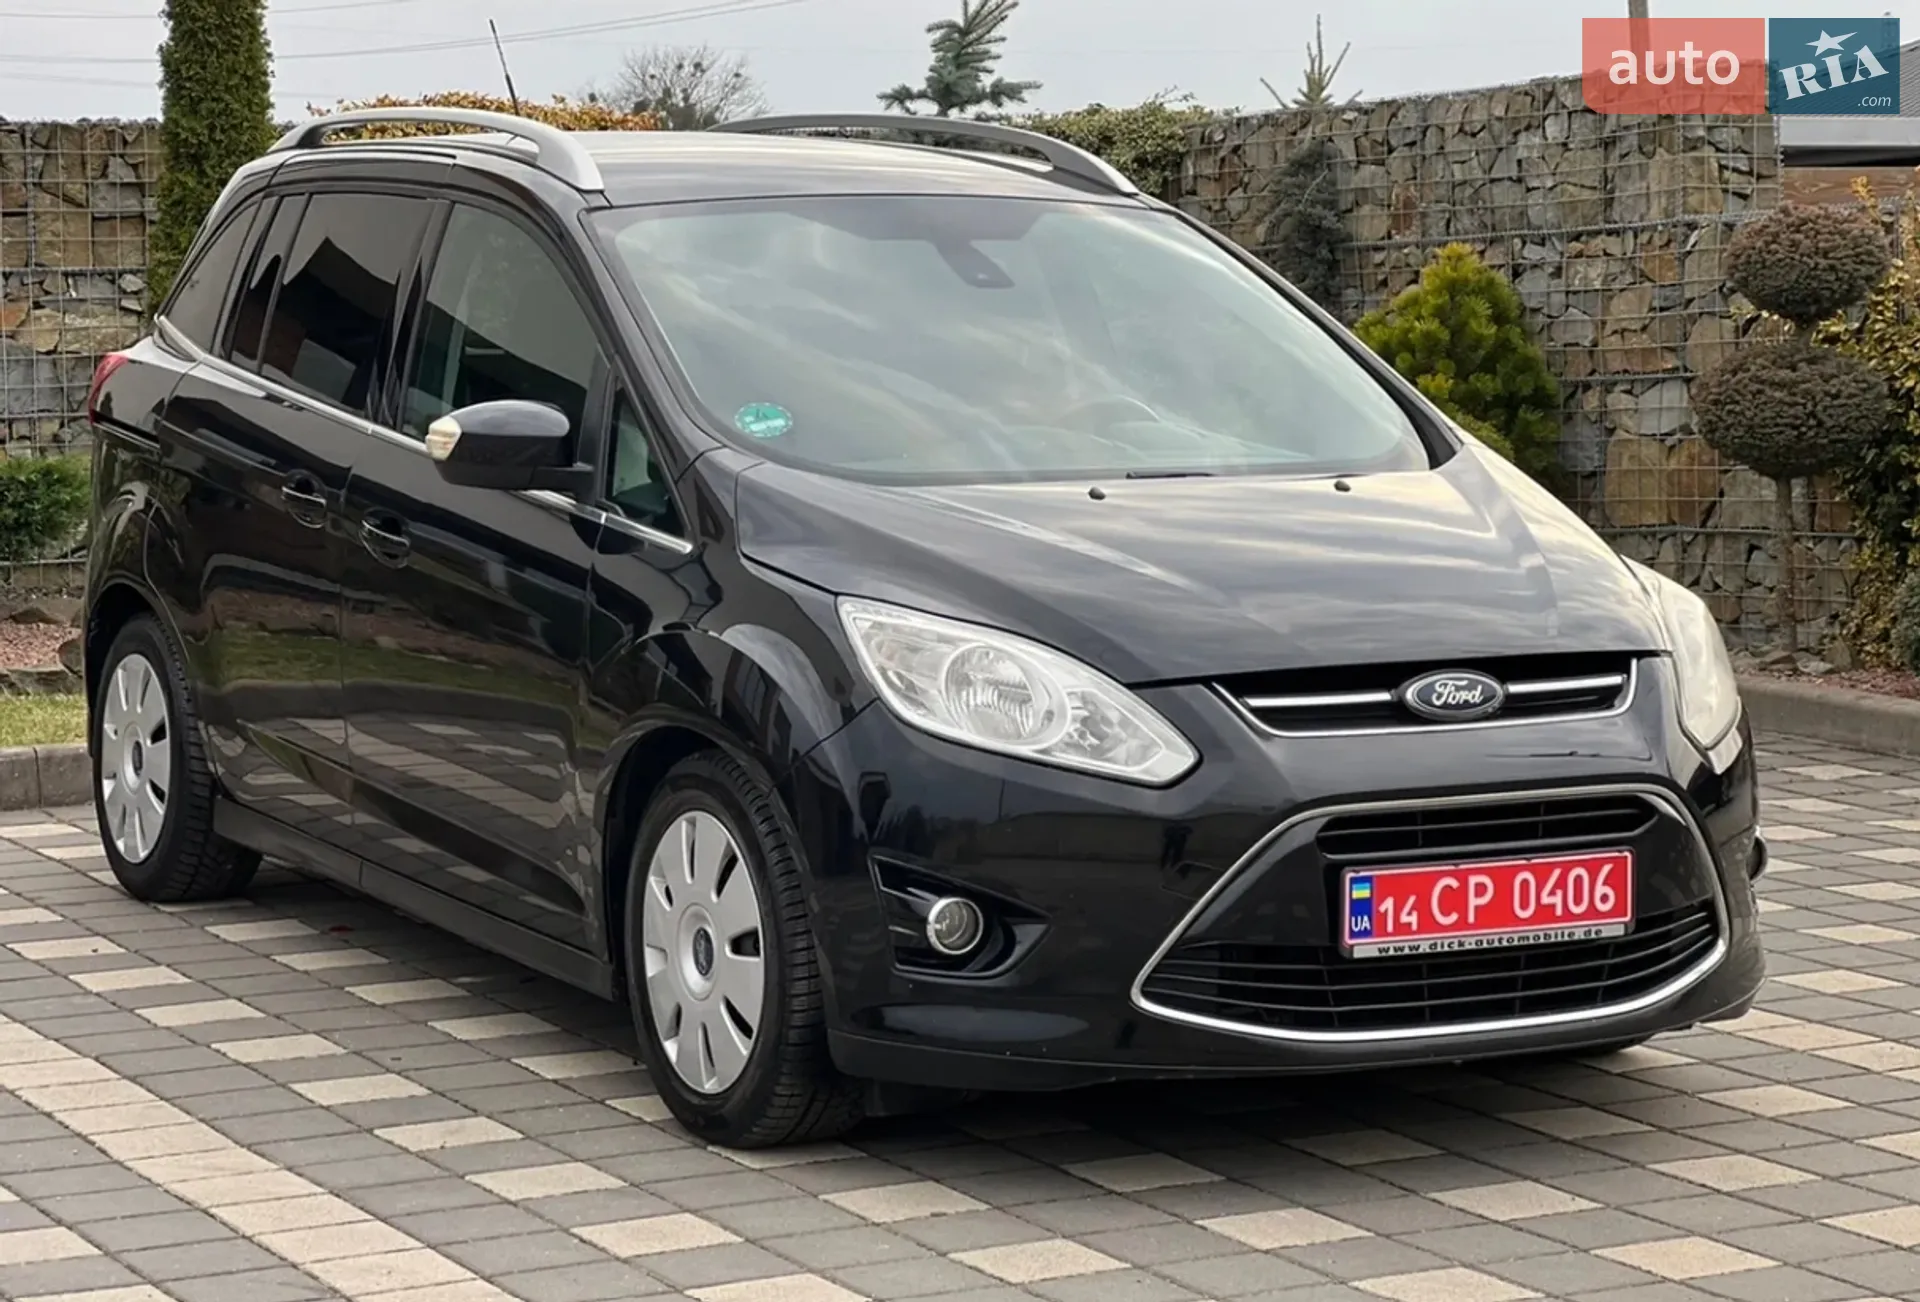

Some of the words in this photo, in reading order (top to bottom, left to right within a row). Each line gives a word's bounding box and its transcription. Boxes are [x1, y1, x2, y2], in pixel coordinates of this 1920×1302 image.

[1431, 679, 1484, 706] Ford
[1378, 895, 1418, 933] 14
[1430, 874, 1494, 925] CP
[1513, 863, 1616, 919] 0406
[1351, 916, 1371, 932] UA
[1377, 926, 1604, 955] www.dick-automobile.de
